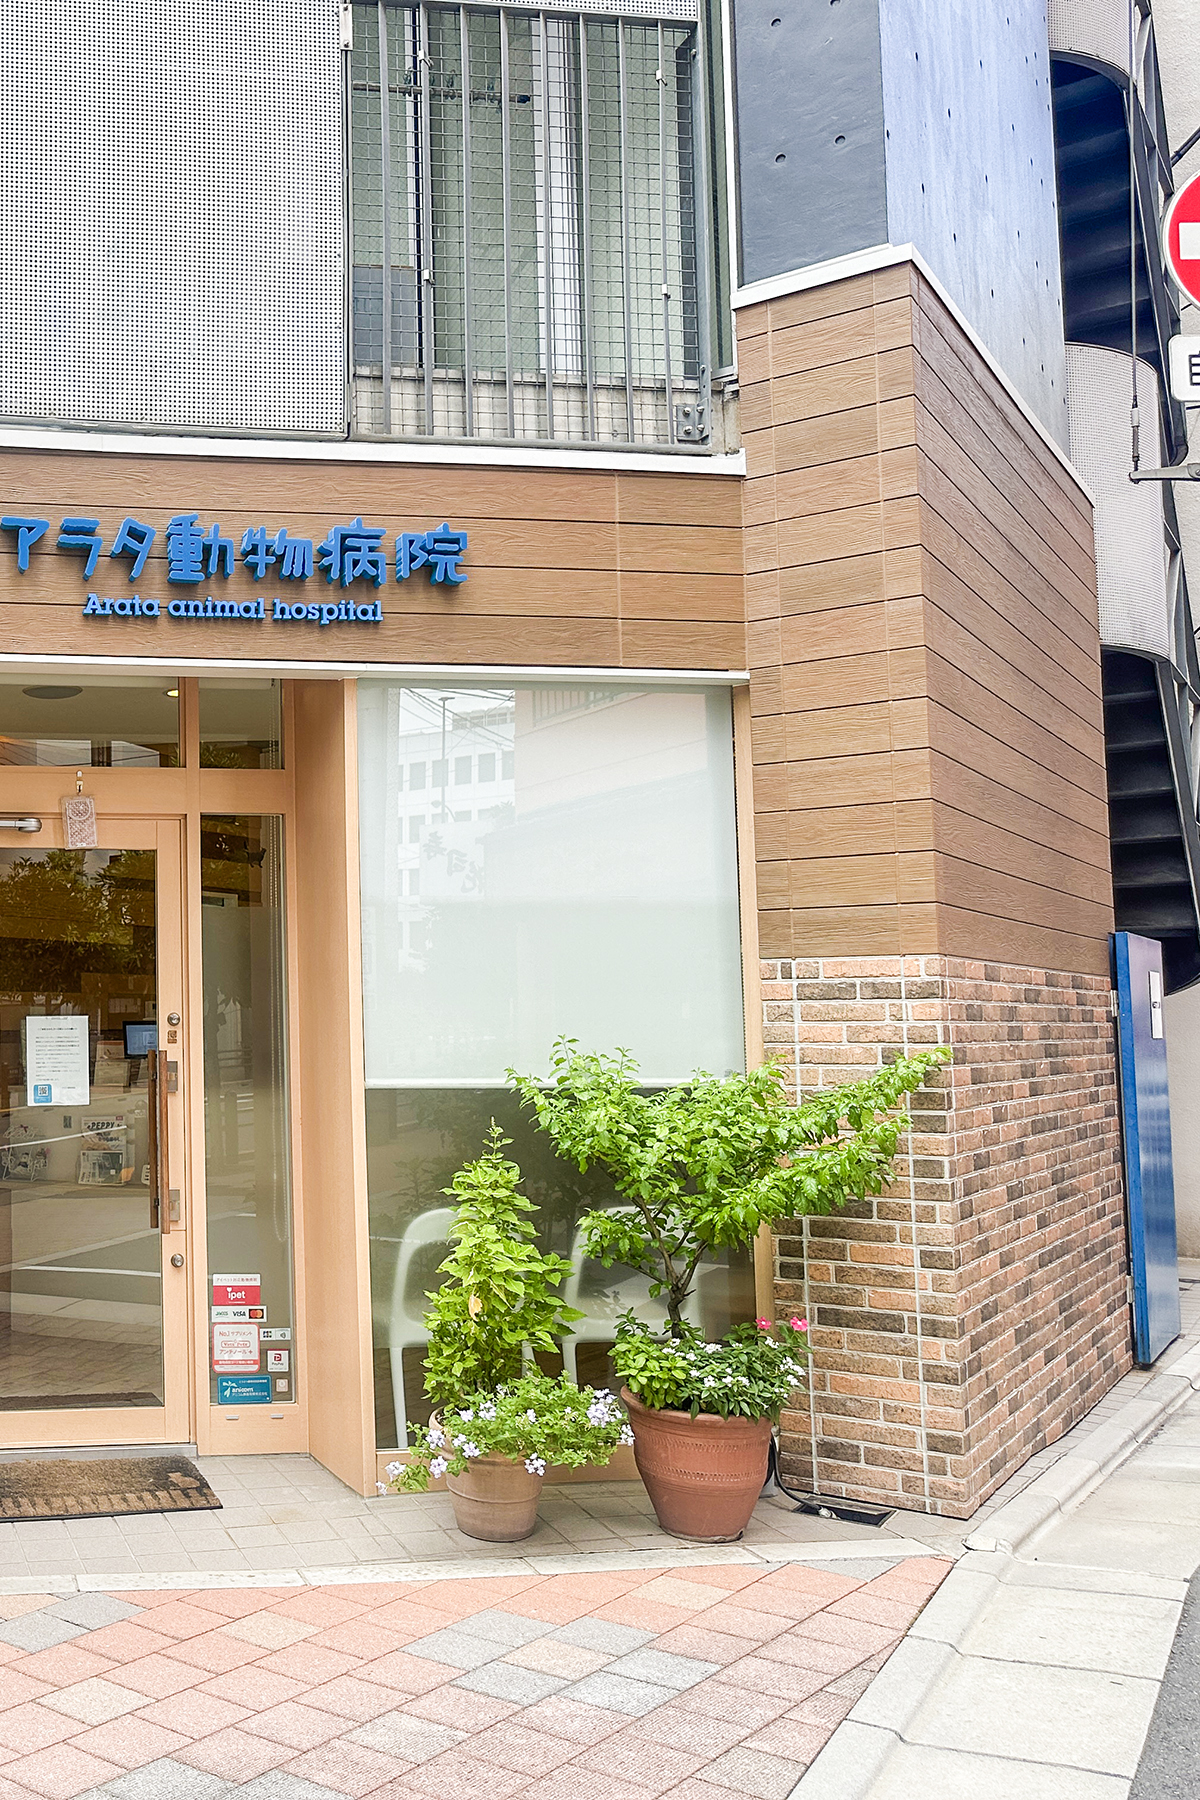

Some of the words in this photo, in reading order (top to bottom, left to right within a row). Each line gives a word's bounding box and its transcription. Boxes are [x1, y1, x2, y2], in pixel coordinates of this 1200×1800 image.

[0, 513, 468, 589] アラタ動物病院
[82, 593, 161, 617] Arata
[168, 596, 266, 619] animal
[272, 598, 384, 626] hospital
[227, 1287, 246, 1301] ipet
